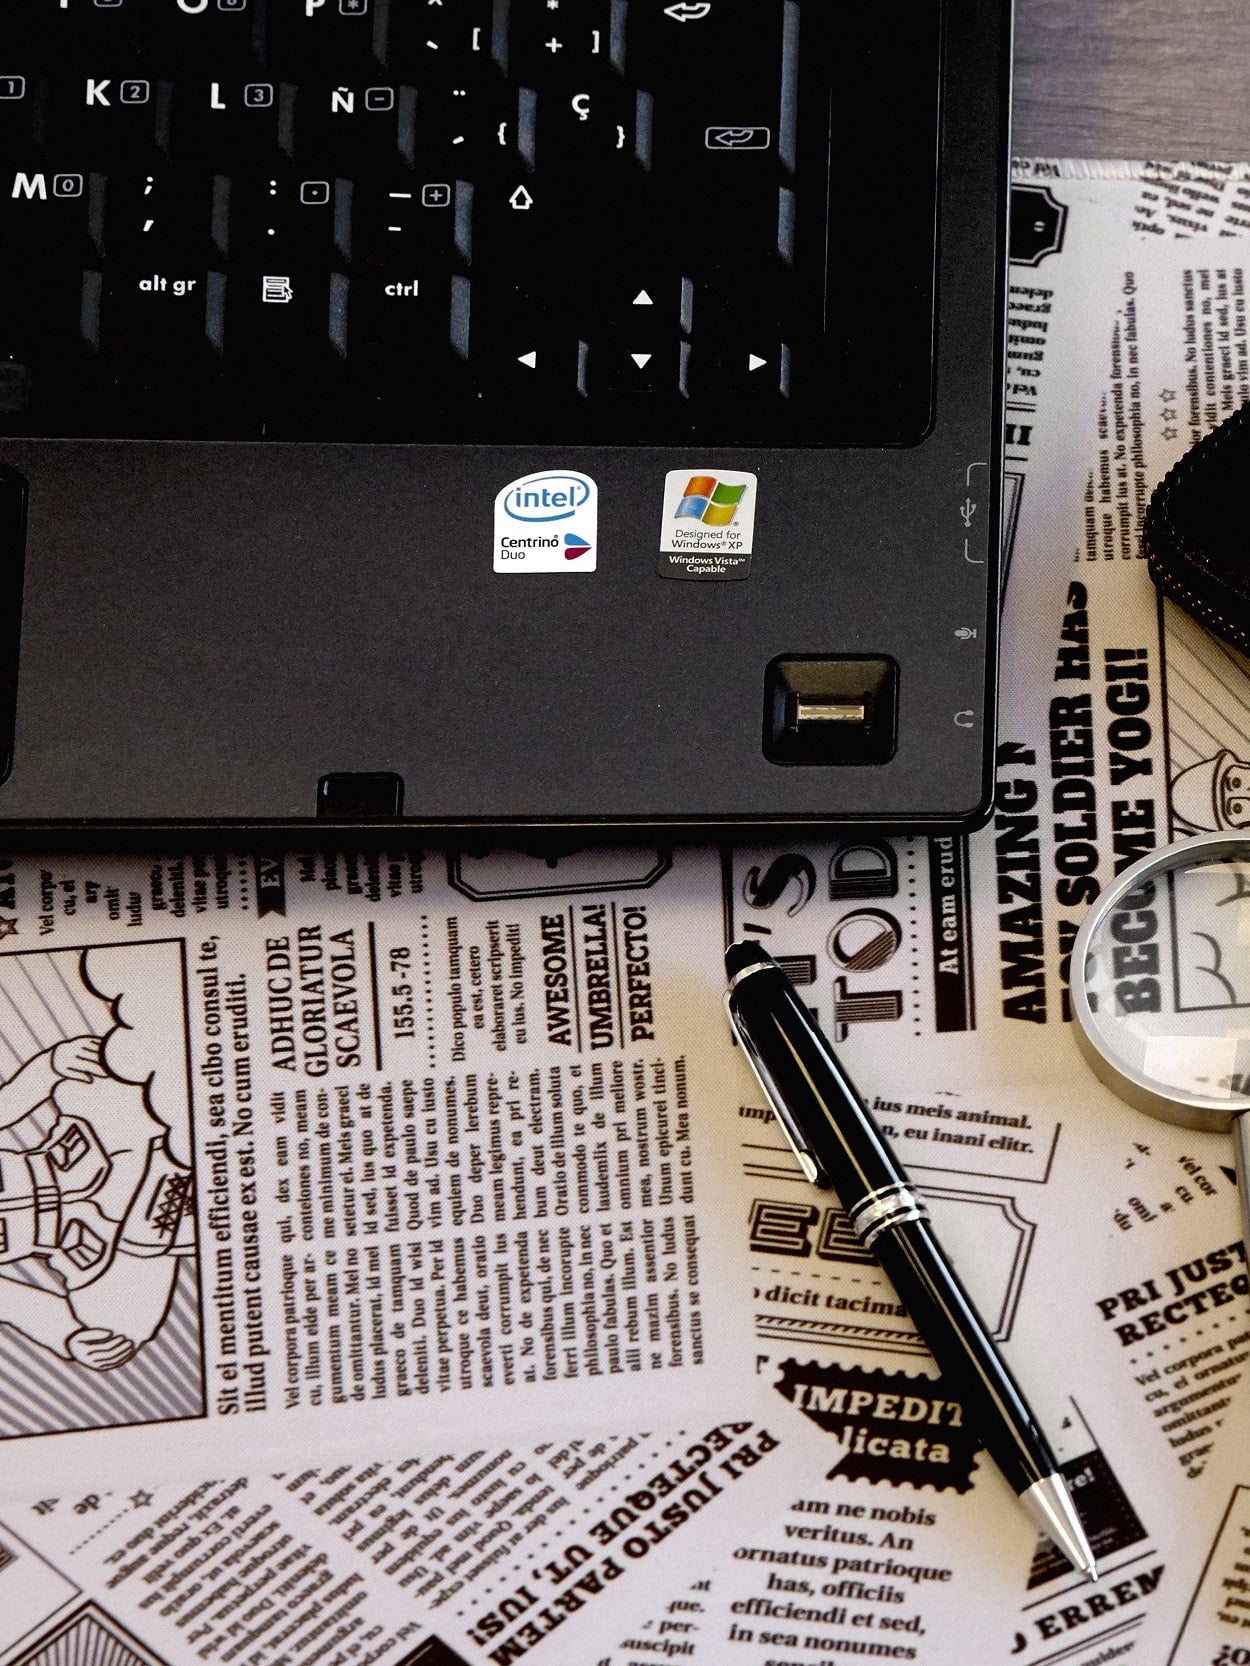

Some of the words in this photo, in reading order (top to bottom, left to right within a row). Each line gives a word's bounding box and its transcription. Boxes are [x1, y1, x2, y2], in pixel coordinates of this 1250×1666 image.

[86, 79, 112, 107] K
[130, 86, 140, 98] 2
[211, 83, 226, 109] L
[254, 89, 264, 102] 3
[332, 87, 354, 113] Ñ
[571, 94, 590, 121] Ç
[11, 172, 48, 200] M
[139, 275, 167, 292] alt
[172, 279, 197, 297] gr
[385, 280, 419, 297] ctrl
[675, 529, 723, 541] Designed
[725, 530, 741, 540] for
[728, 541, 743, 550] XP
[501, 549, 526, 560] Duo
[669, 556, 713, 566] Windows
[686, 564, 726, 574] Capable
[1103, 647, 1153, 786] YOGI!
[1048, 693, 1100, 907] SOLDIER
[941, 894, 958, 942] eam
[995, 779, 1045, 1023] AMAZING
[198, 935, 221, 962] te,
[266, 936, 291, 973] DE
[445, 916, 464, 980] tamquam
[939, 948, 959, 975] At
[539, 913, 572, 1047] AWESOME
[581, 903, 614, 1051] UMBRELLA!
[622, 905, 655, 1042] PERFECTO!
[195, 966, 222, 1037] consul
[224, 973, 250, 1053] eruditi.
[297, 924, 329, 1078] GLORIATUR
[330, 928, 361, 1068] SCAEVOLA
[447, 982, 468, 1029] populo
[268, 977, 296, 1072] ADHUC
[200, 1042, 224, 1088] cibo
[450, 1031, 466, 1062] Dico
[234, 1056, 252, 1103] cum
[208, 1092, 226, 1128] sea
[231, 1107, 254, 1137] No
[869, 1096, 903, 1113] ius
[905, 1104, 953, 1119] meis
[955, 1110, 1032, 1130] animal.
[236, 1140, 256, 1178] est.
[903, 1128, 929, 1140] eu
[932, 1127, 986, 1148] inani
[987, 1135, 1034, 1154] elitr.
[204, 1133, 232, 1242] efficiendi,
[240, 1181, 258, 1206] ex
[242, 1210, 261, 1283] causae
[212, 1248, 237, 1356] mentitum
[280, 1254, 301, 1325] patrioque
[764, 1285, 820, 1307] dicit
[1095, 1279, 1163, 1321] PRI
[243, 1287, 271, 1358] putent
[285, 1326, 302, 1384] corpora
[217, 1387, 239, 1416] Sit
[284, 1386, 300, 1409] Vel
[718, 1429, 781, 1481] PRI
[622, 1471, 724, 1559] JUSTO
[835, 1504, 866, 1518] ne
[870, 1507, 936, 1526] nobis
[785, 1525, 874, 1547] veritus.
[879, 1532, 914, 1551] An
[532, 1544, 594, 1585] UT,
[733, 1547, 828, 1568] ornatus
[831, 1557, 953, 1582] patrioque
[766, 1572, 815, 1597] has,
[466, 1585, 540, 1647] IUS!
[487, 1556, 625, 1666] PARTEM
[730, 1597, 847, 1625] efficiendi
[851, 1613, 874, 1628] et
[879, 1615, 926, 1636] sed,
[728, 1623, 754, 1643] in
[758, 1632, 799, 1647] sea
[804, 1636, 917, 1660] nonumes
